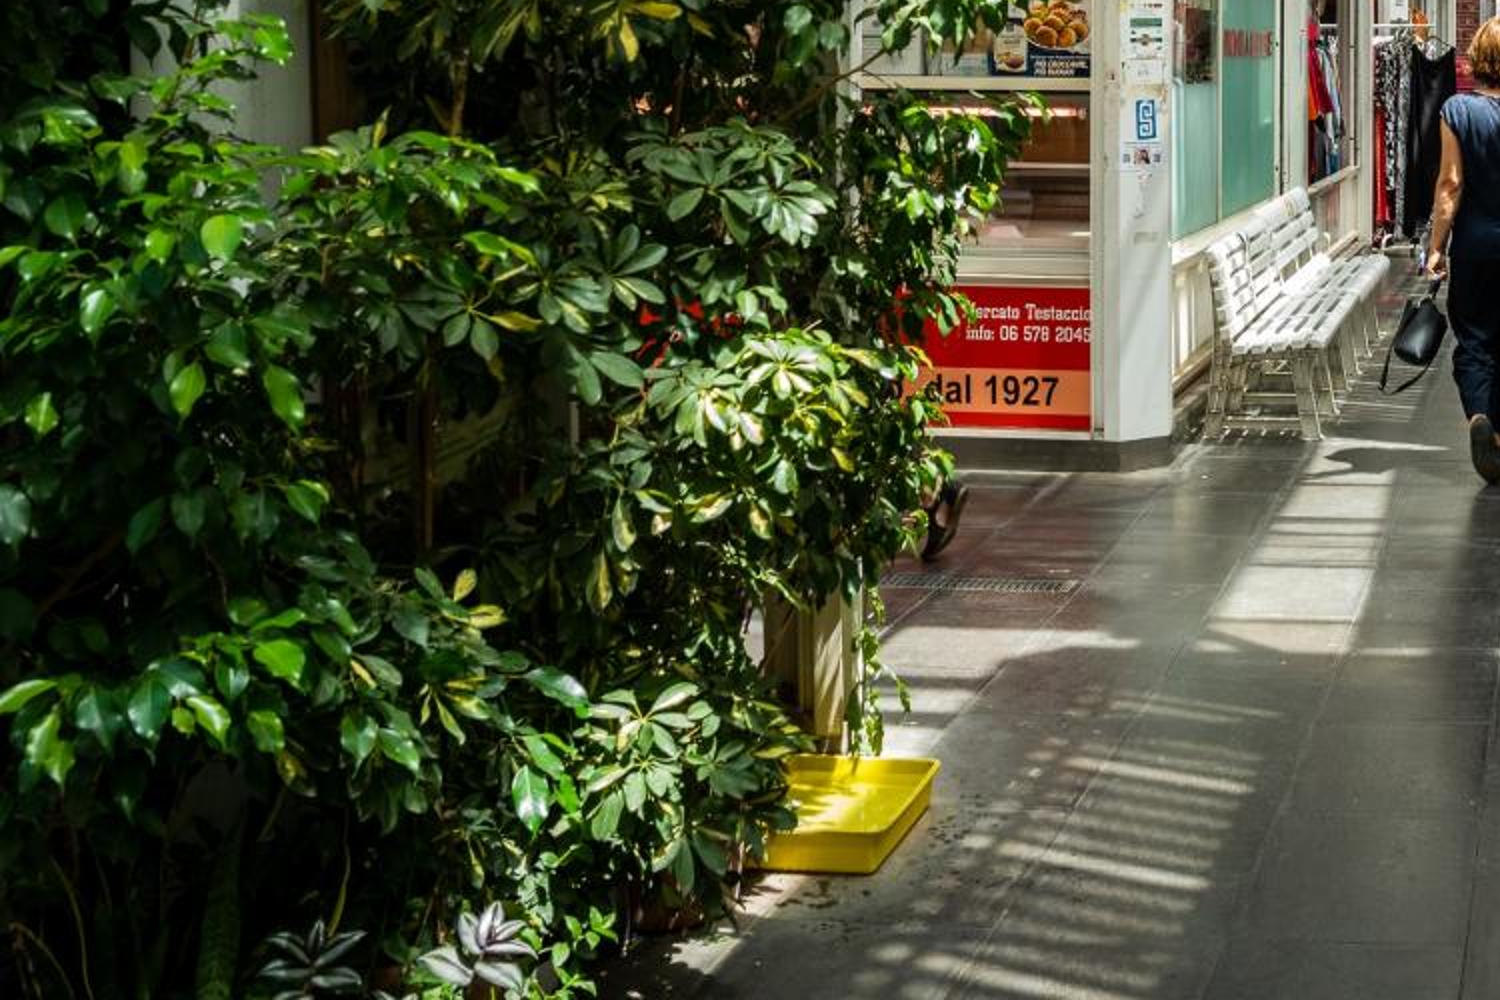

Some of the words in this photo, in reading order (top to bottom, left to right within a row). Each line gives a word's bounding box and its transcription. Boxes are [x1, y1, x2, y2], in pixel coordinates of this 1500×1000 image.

[1024, 303, 1092, 322] Testaccio
[965, 326, 996, 341] info:
[999, 325, 1019, 341] 06
[1023, 326, 1049, 342] 578
[924, 373, 972, 404] dal
[985, 374, 1060, 407] 1927
